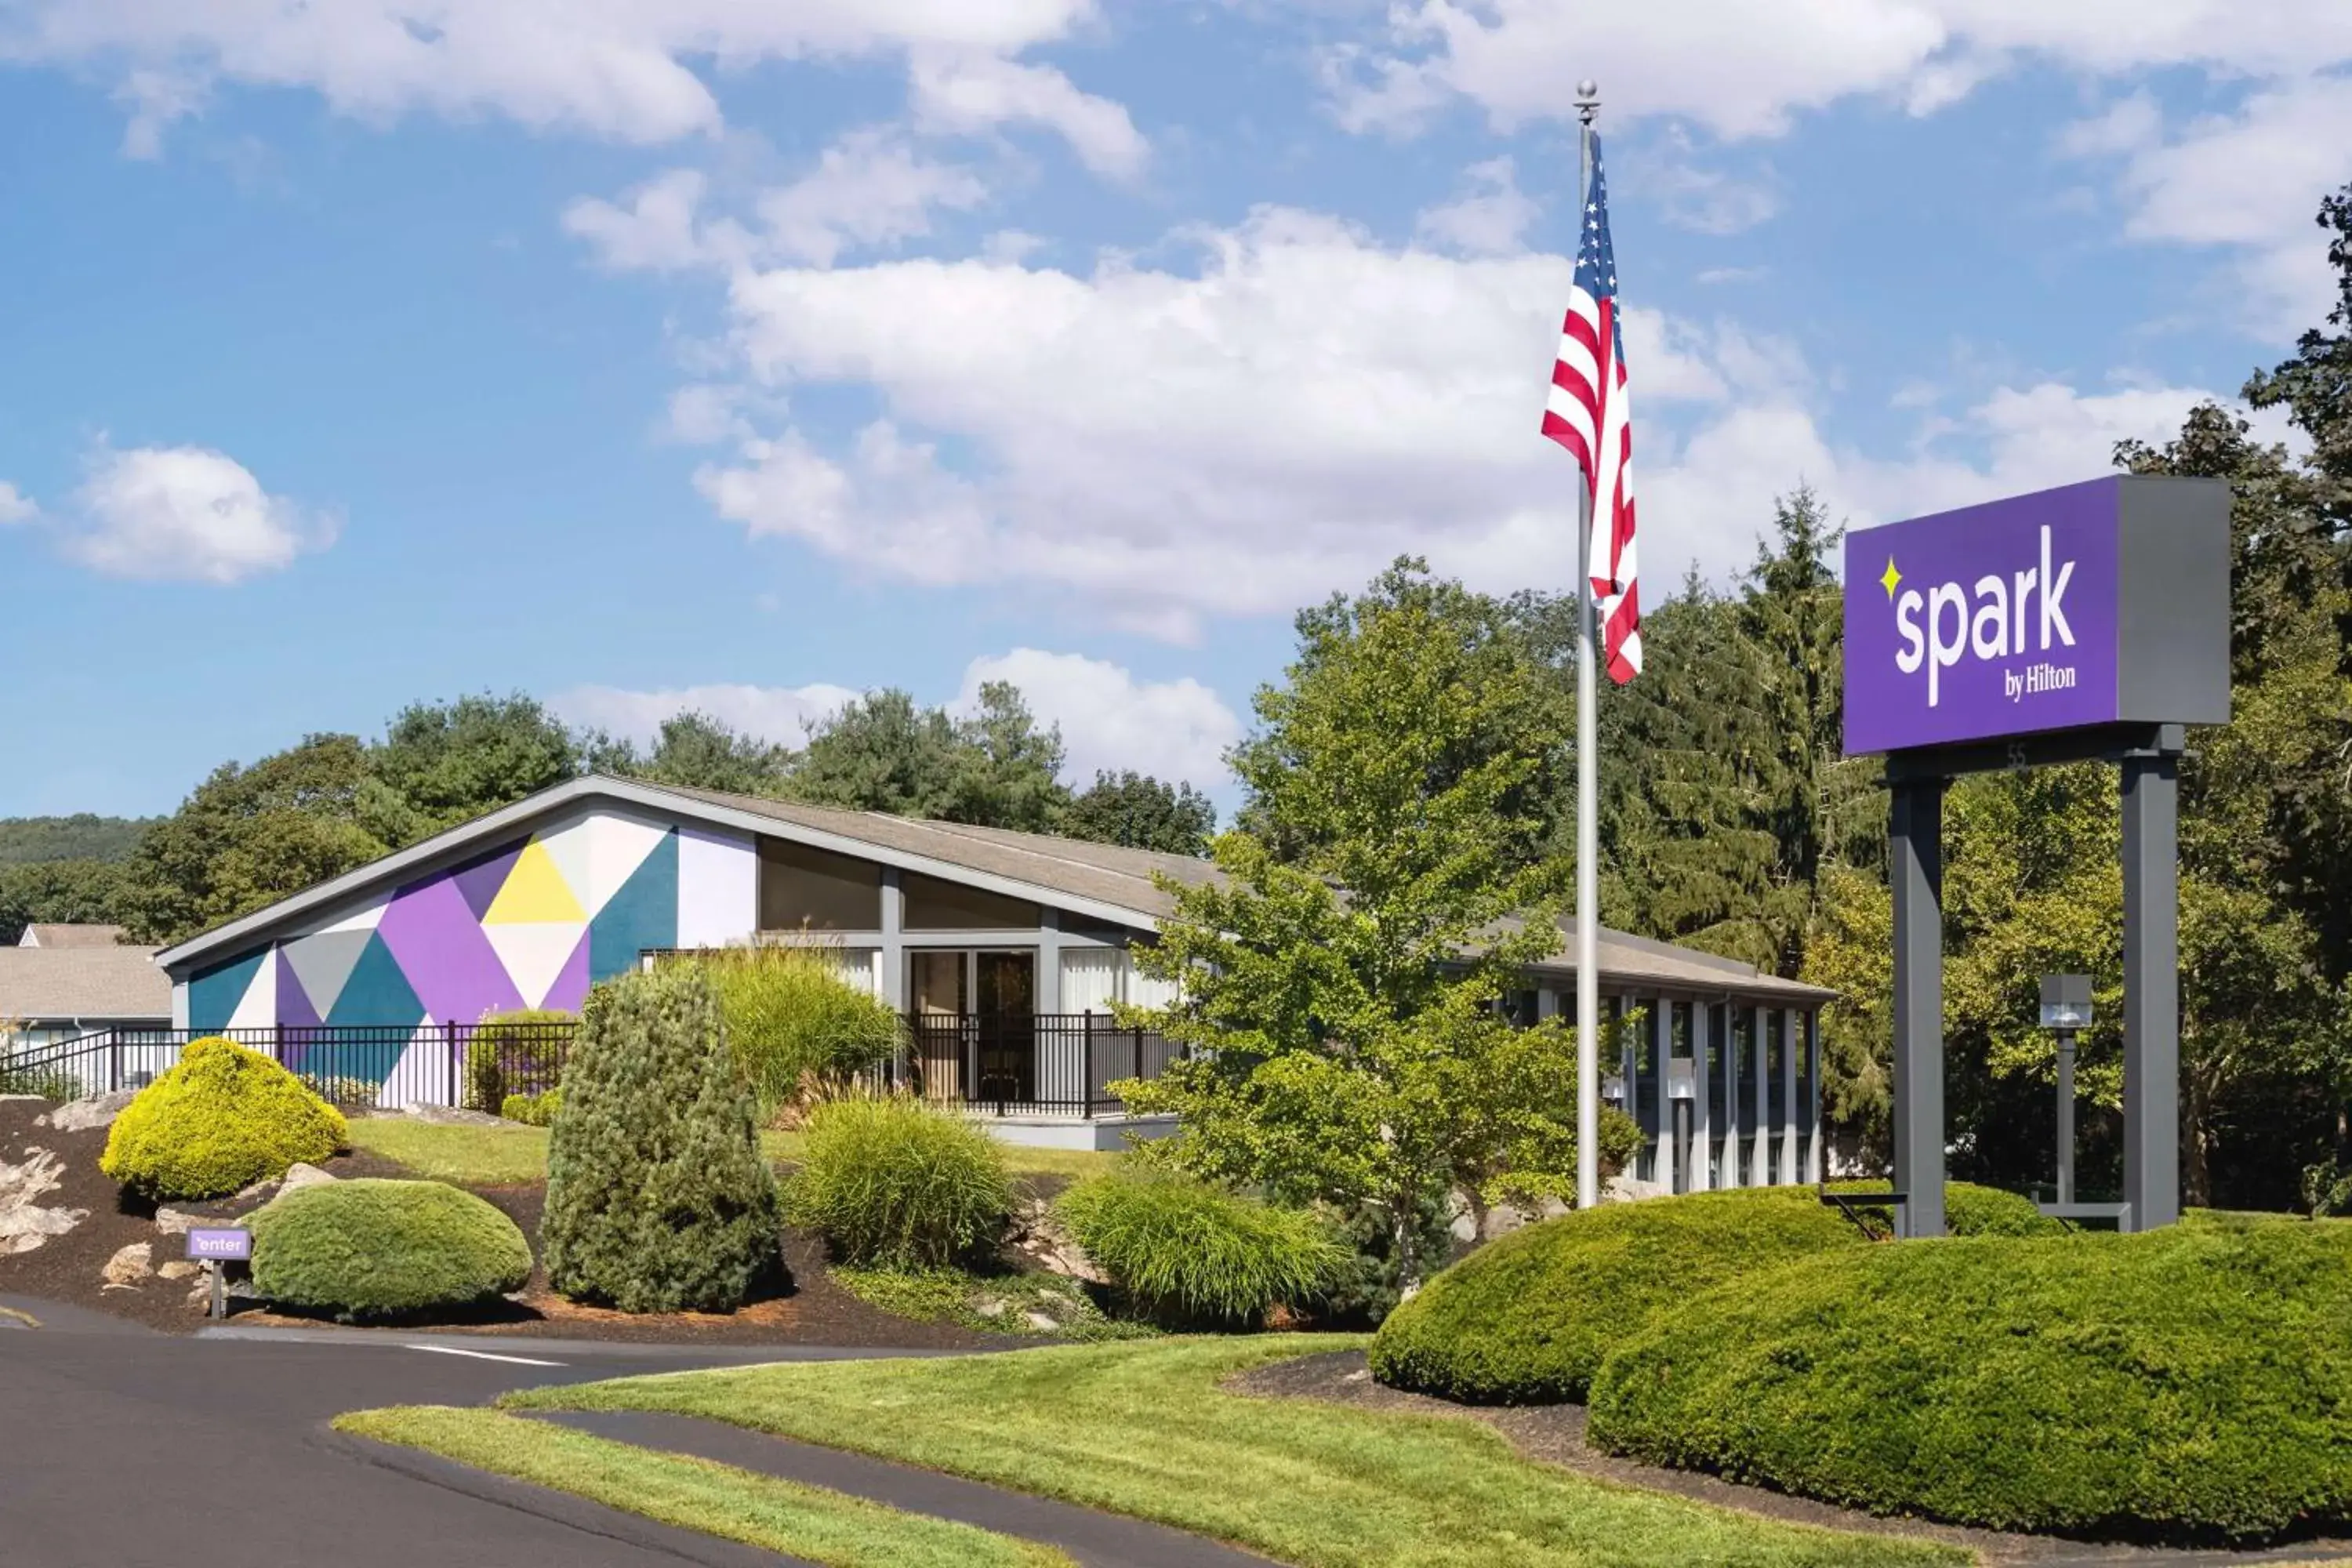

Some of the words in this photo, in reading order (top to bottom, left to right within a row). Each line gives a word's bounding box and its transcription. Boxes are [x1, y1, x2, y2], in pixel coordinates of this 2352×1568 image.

[1895, 524, 2076, 707] spark
[2005, 669, 2024, 703] by
[2026, 662, 2076, 693] Hilton
[198, 1238, 242, 1252] enter
